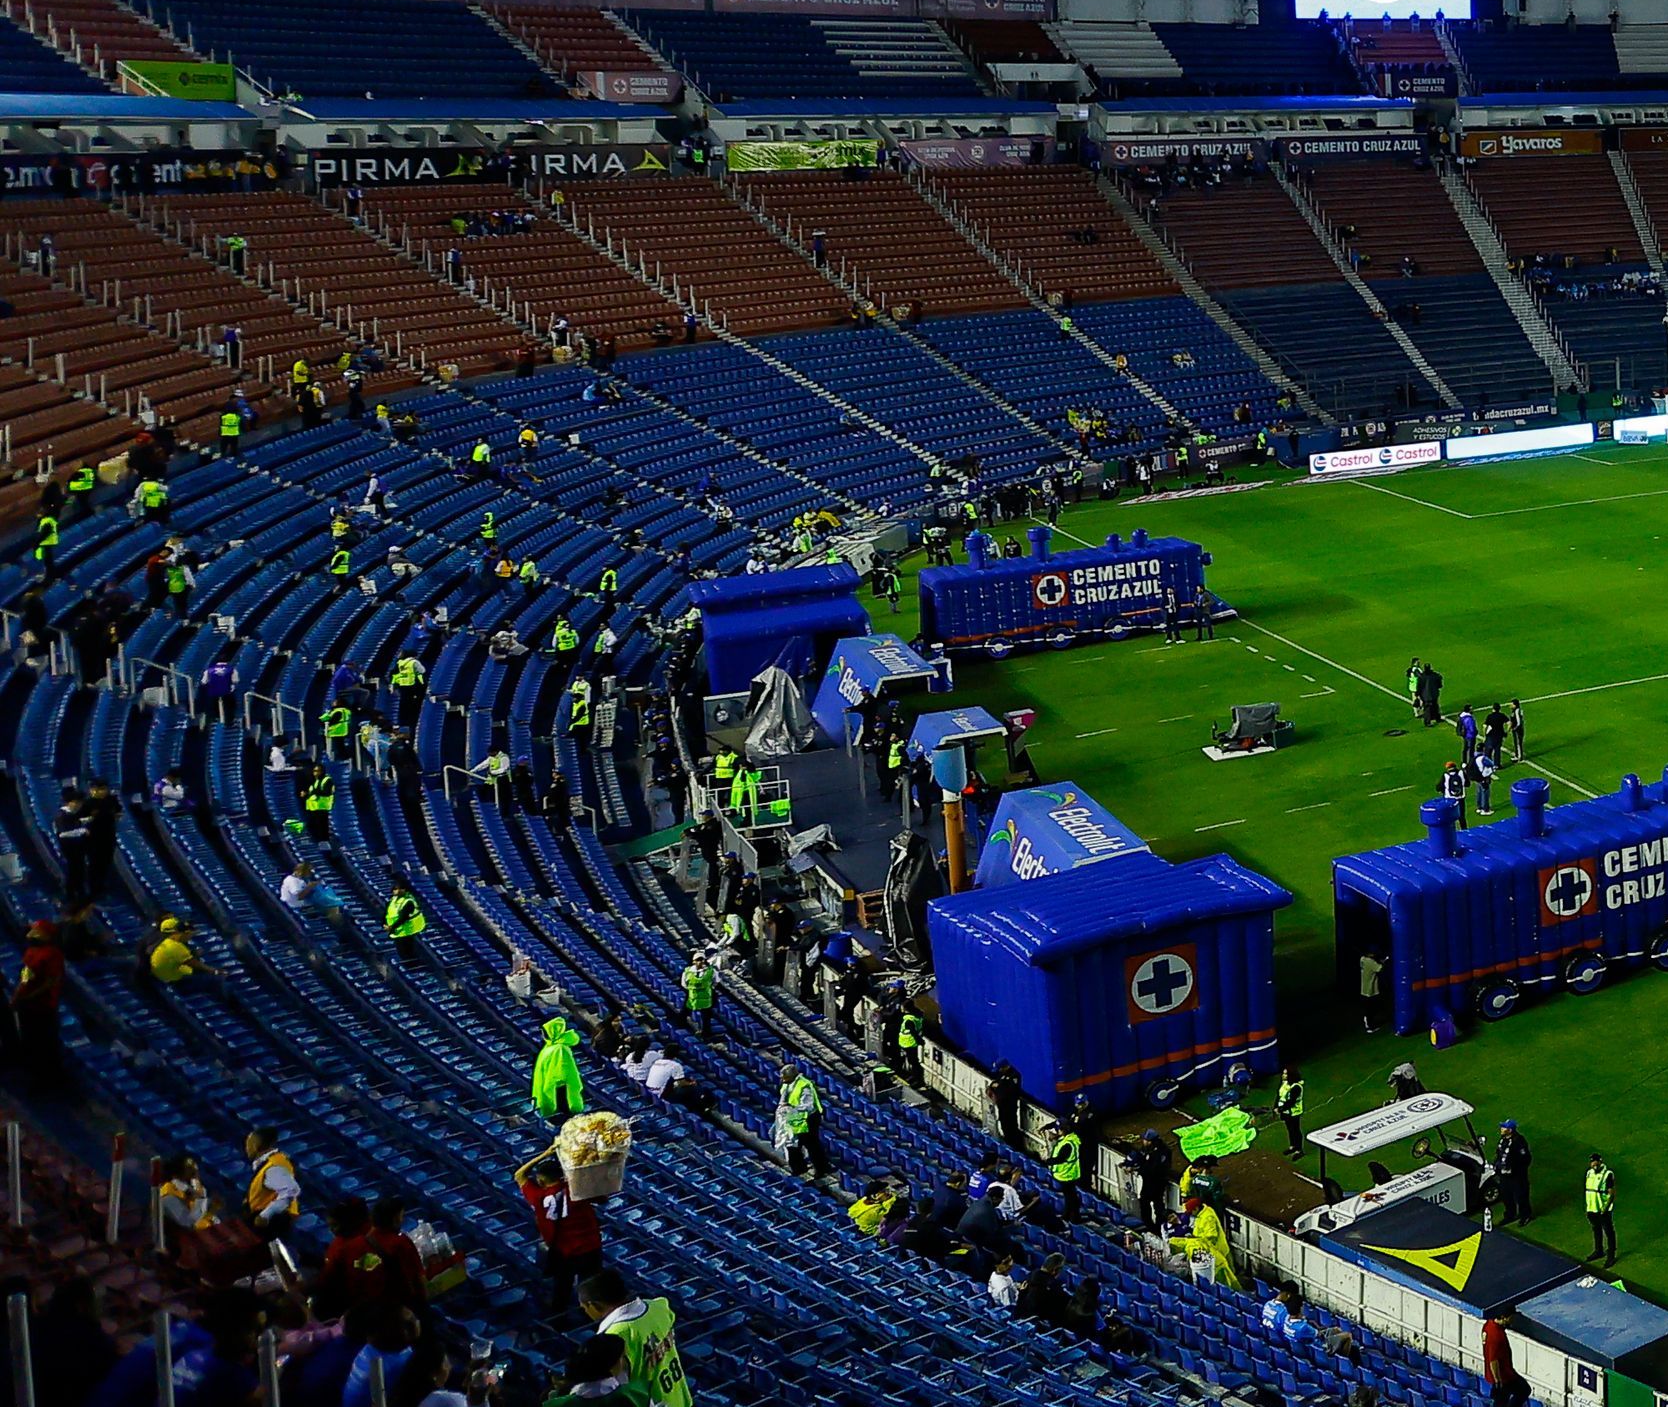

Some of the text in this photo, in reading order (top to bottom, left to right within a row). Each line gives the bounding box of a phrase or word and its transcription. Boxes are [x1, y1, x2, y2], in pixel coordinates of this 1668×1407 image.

[1003, 2, 1046, 13] CRUZ AZUL
[1130, 143, 1222, 159] CEMENTO CRUZ
[1304, 140, 1422, 154] CEMENTO CRUZ AZUL
[1651, 135, 1664, 143] LA
[313, 156, 441, 183] PIRMA
[1331, 445, 1438, 468] Castrol Castrol
[1073, 559, 1161, 586] CEMENTO
[1075, 579, 1163, 605] CRUZ AZUL
[1048, 806, 1127, 855] Electrolit
[1606, 871, 1667, 910] CRUZ
[659, 1357, 683, 1394] 68
